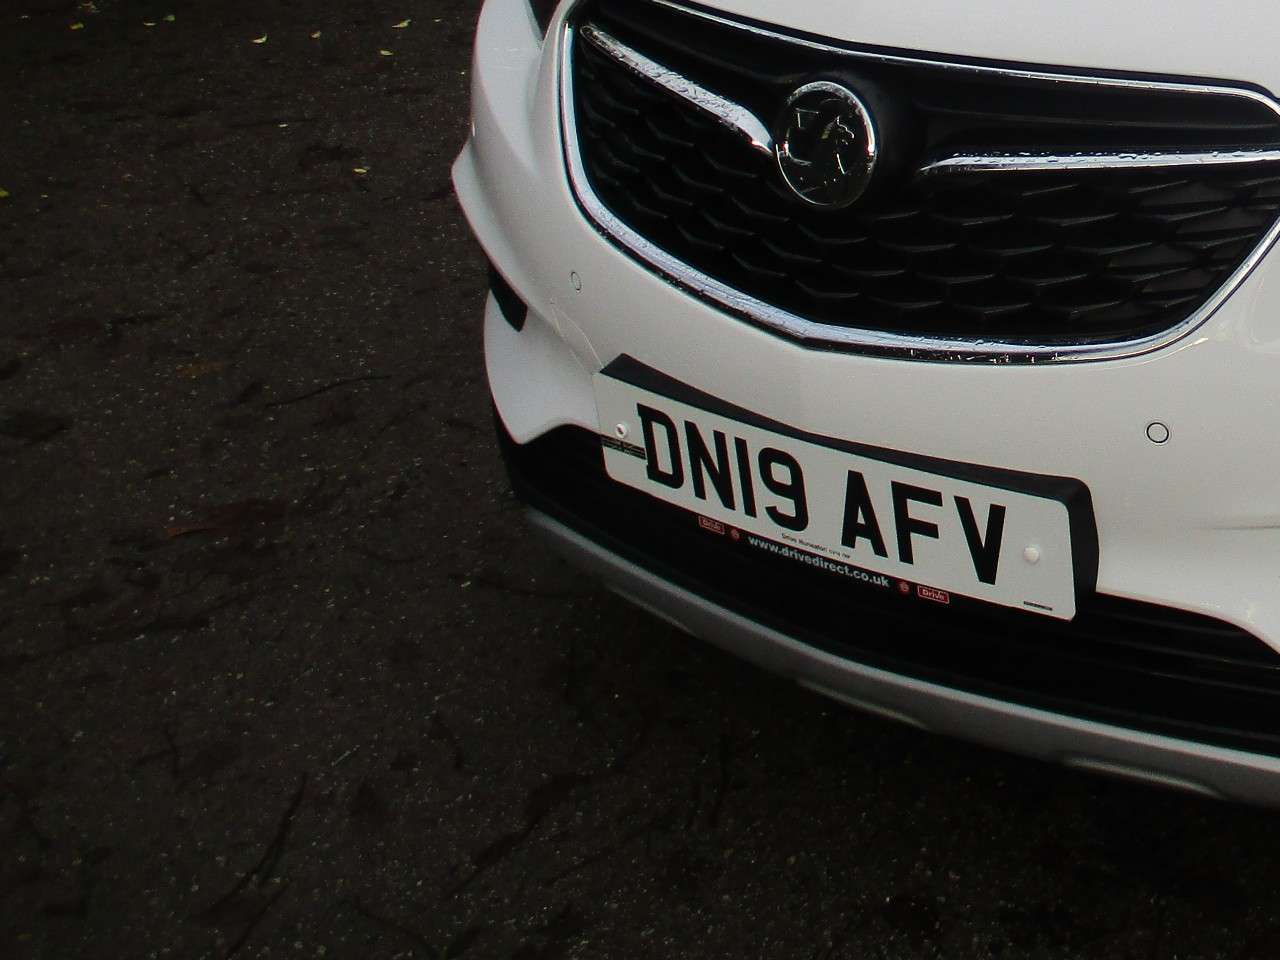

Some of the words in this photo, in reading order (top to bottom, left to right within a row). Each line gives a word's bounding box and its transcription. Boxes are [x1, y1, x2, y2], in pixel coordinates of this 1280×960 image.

[637, 403, 810, 532] DN19
[841, 469, 1006, 586] AFV
[748, 535, 890, 588] www.drivedirect.co.uk
[922, 588, 945, 601] Drive
